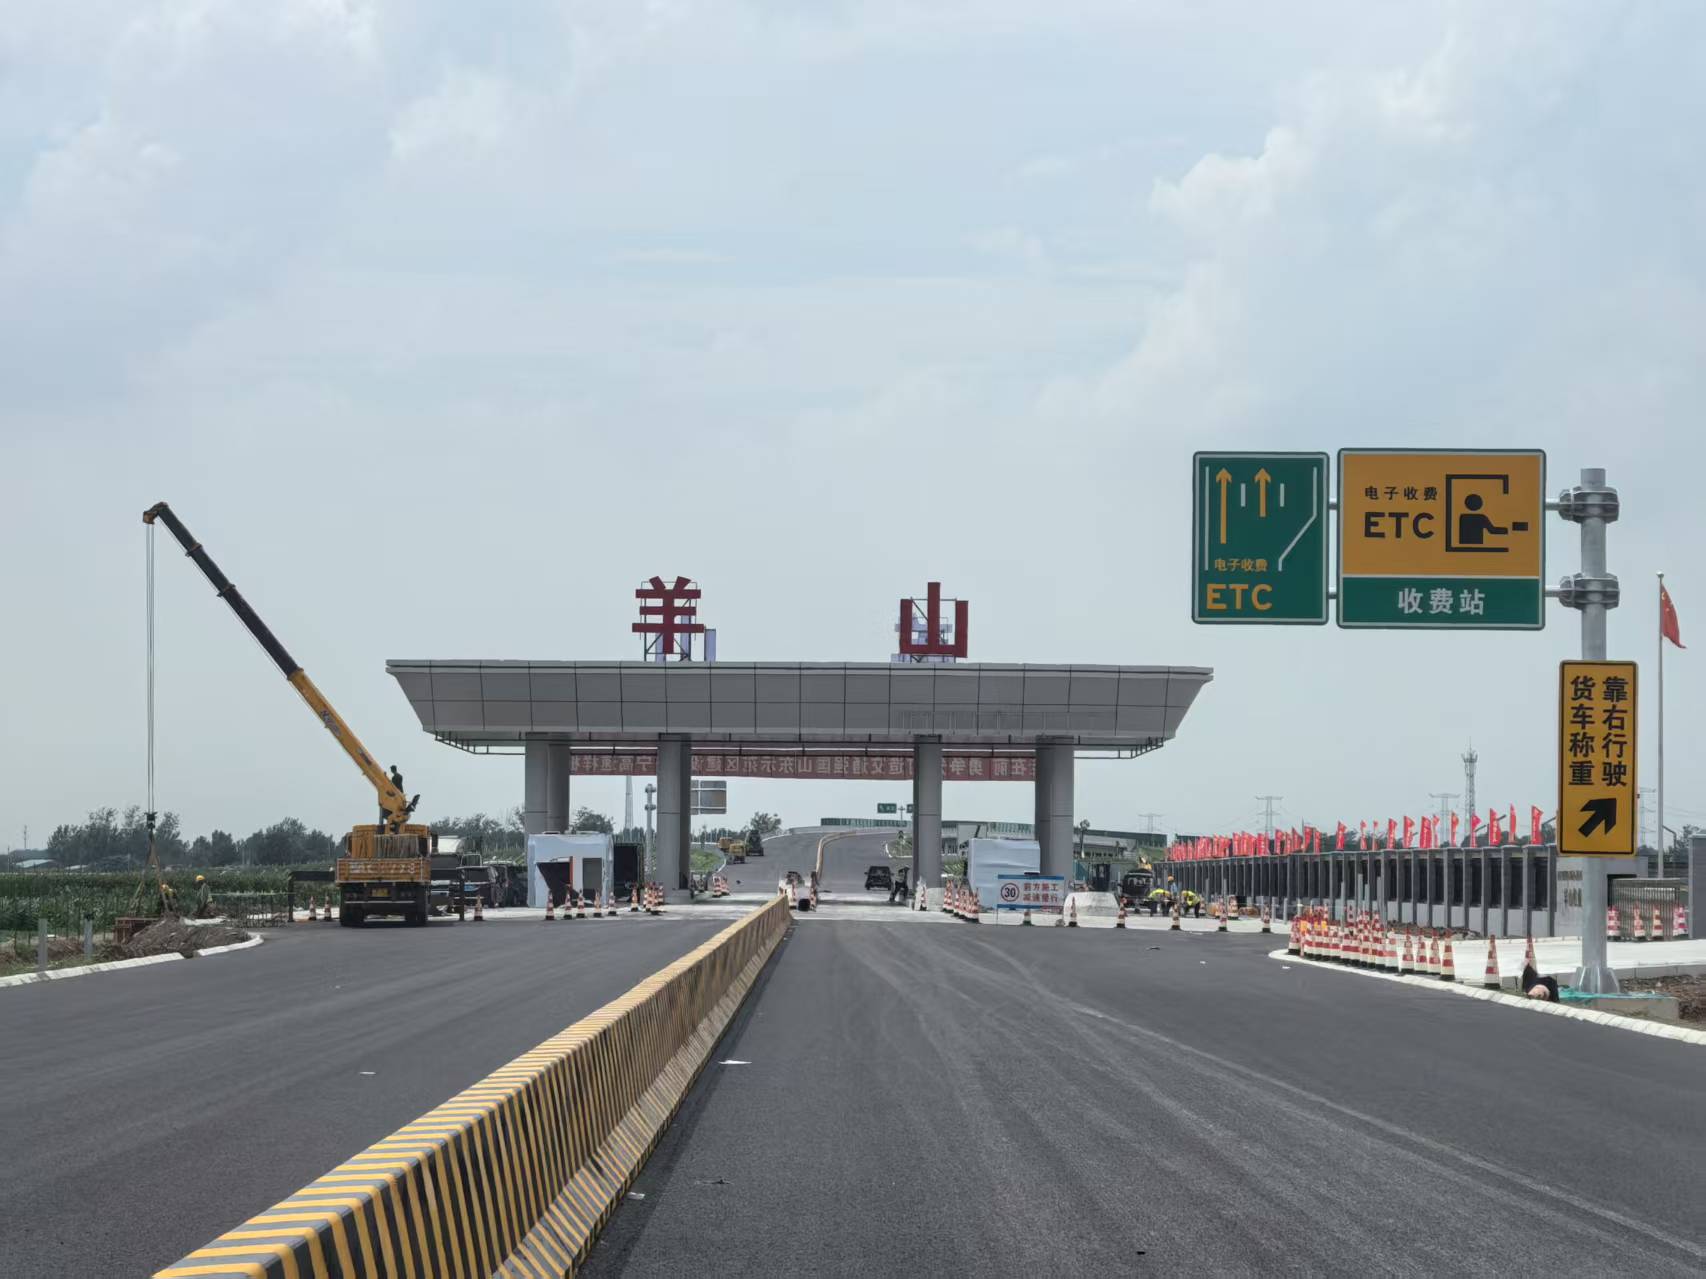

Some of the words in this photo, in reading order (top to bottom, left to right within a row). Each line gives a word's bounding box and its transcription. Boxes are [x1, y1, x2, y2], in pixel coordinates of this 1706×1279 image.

[1364, 486, 1438, 501] 电子收费
[1364, 512, 1435, 539] ETC
[1214, 558, 1268, 572] 电子收费
[1206, 584, 1272, 610] ETC
[1398, 588, 1486, 615] 收费站
[632, 575, 705, 655] 羊
[899, 581, 969, 658] 山
[1568, 675, 1596, 786] 货车称重
[1601, 675, 1629, 787] 靠右行驶
[1004, 887, 1016, 898] 30
